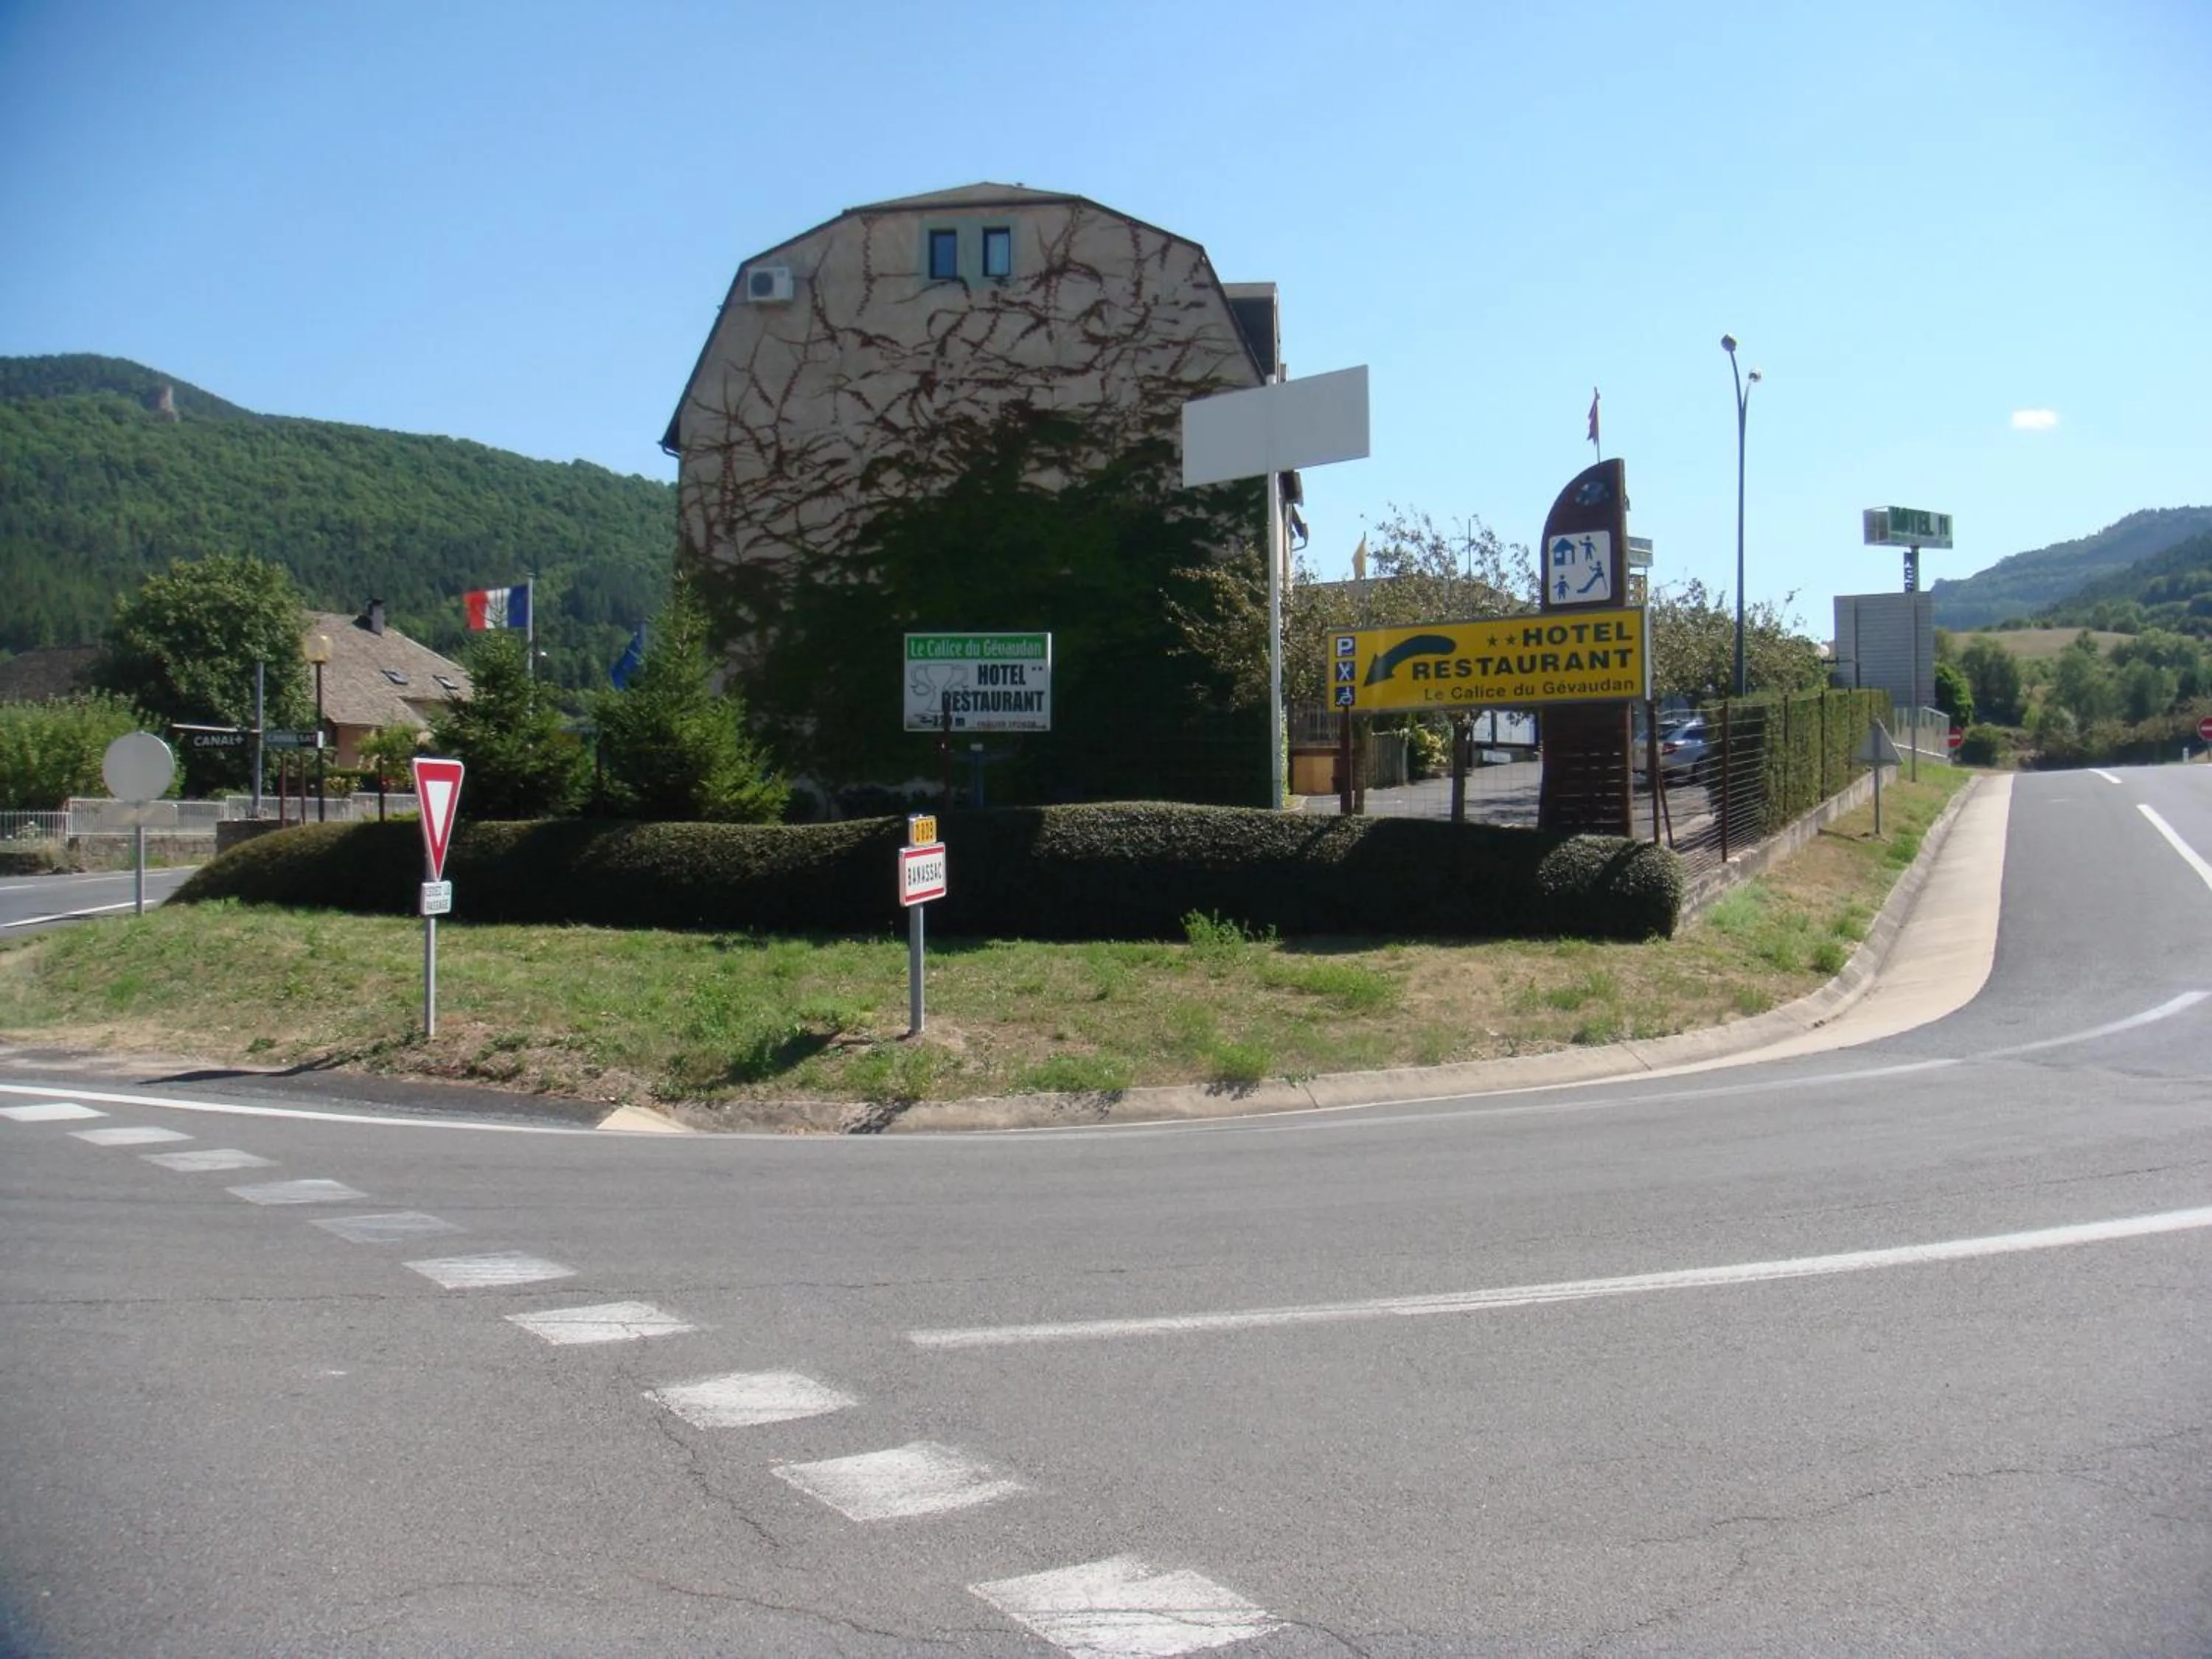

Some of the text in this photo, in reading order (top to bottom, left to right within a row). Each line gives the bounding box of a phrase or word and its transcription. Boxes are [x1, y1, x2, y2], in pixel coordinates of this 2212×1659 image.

[1523, 621, 1632, 647] HOTEL
[911, 638, 1042, 657] Le Calice du Gévaudan
[978, 664, 1026, 686] HOTEL
[1413, 648, 1633, 680] RESTAURANT
[1425, 678, 1633, 700] Le Calice du Gévaudan
[942, 690, 1044, 712] RESTAURANT
[193, 734, 244, 747] CANAL+
[908, 861, 942, 887] BANASSAC
